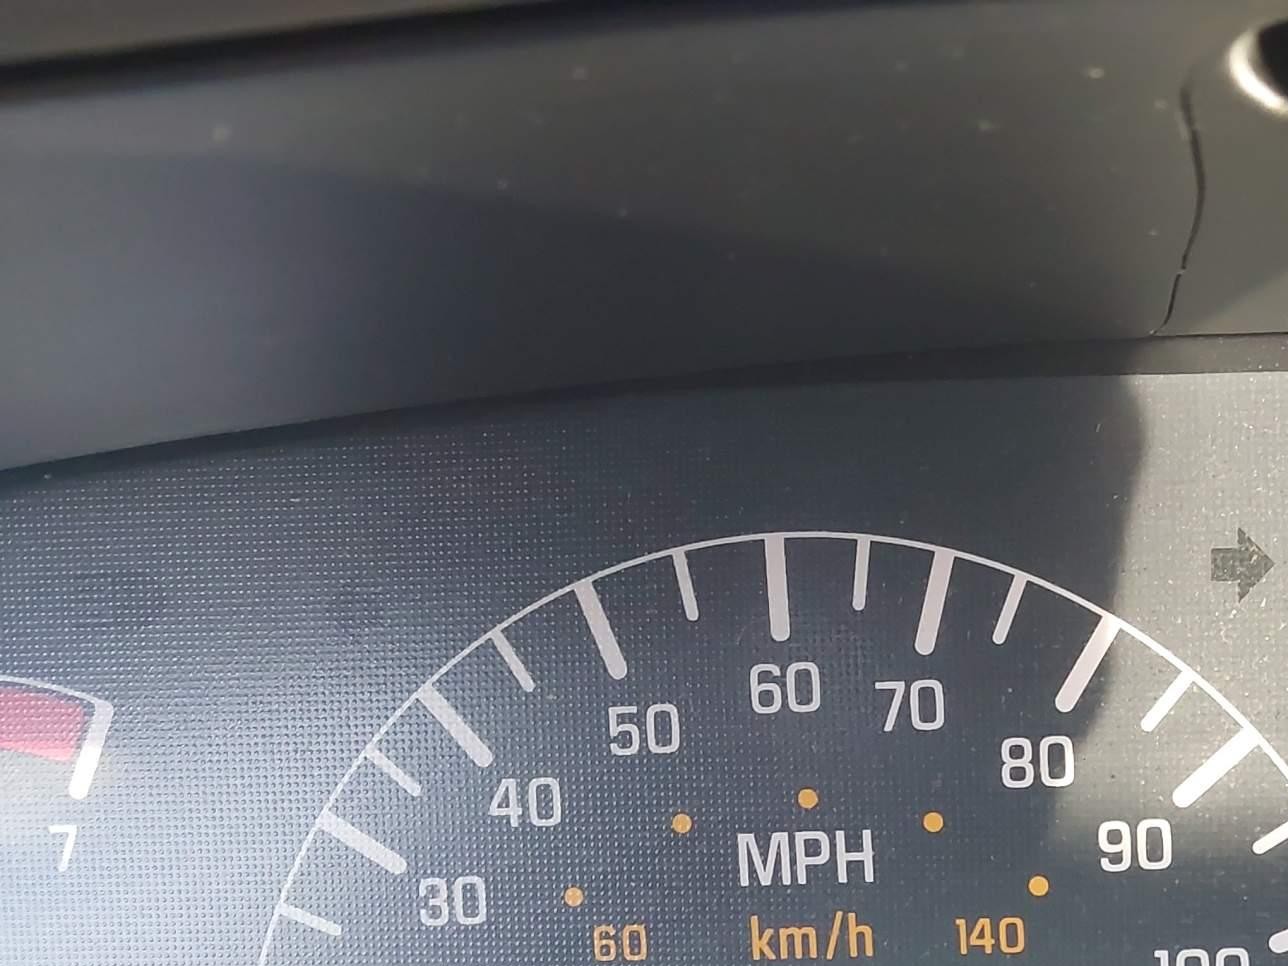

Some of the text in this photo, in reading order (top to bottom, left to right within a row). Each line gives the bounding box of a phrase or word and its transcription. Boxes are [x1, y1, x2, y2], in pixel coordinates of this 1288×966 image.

[750, 662, 820, 714] 60
[874, 679, 944, 733] 70
[608, 703, 681, 755] 50
[1002, 735, 1074, 788] 80
[488, 777, 562, 827] 40
[48, 825, 78, 872] 7
[737, 830, 875, 886] MPH
[1099, 819, 1172, 872] 90
[419, 876, 486, 925] 30
[594, 924, 648, 961] 60
[751, 911, 874, 960] km/h
[955, 918, 1025, 955] 140
